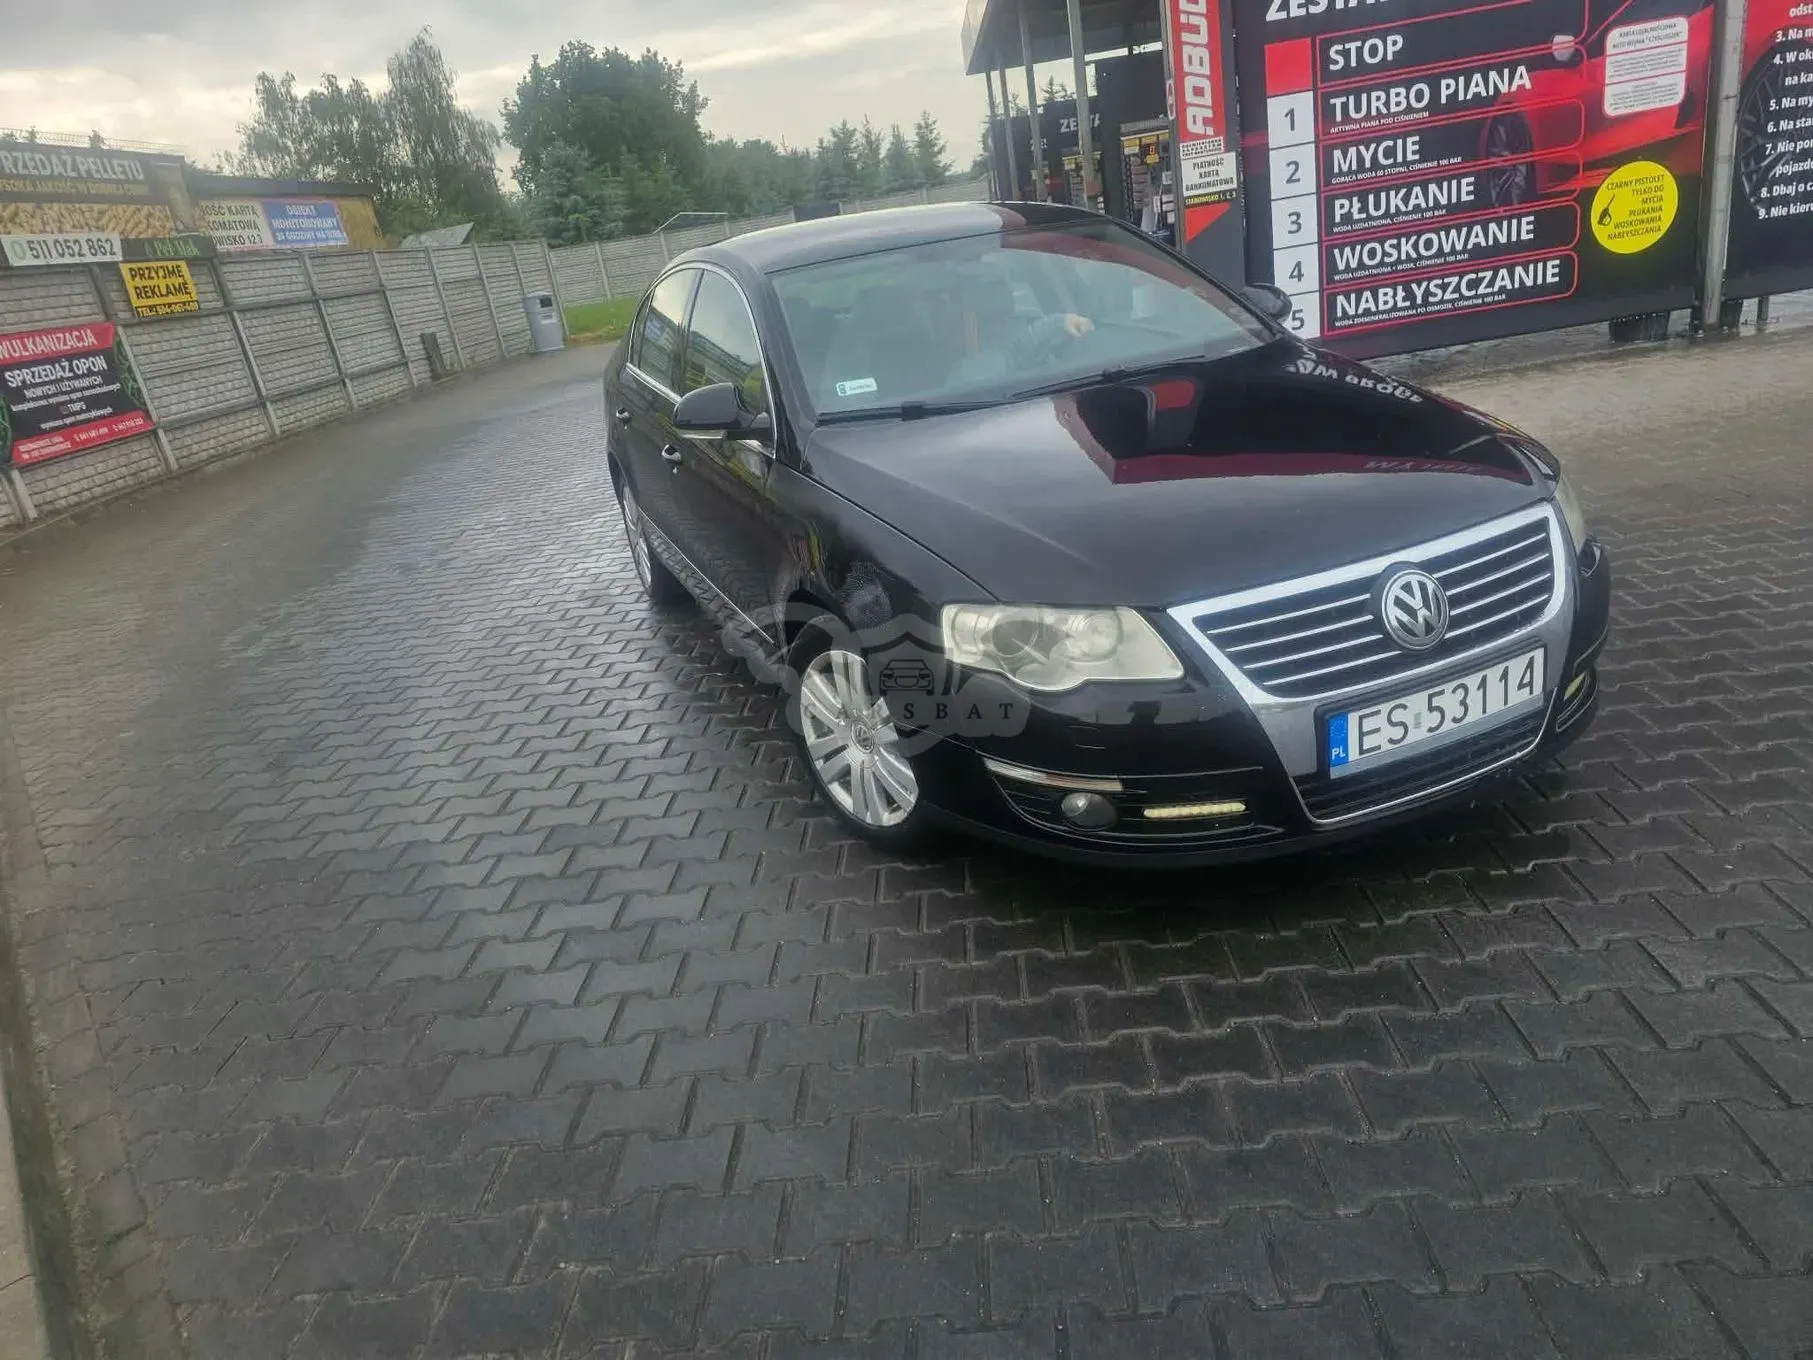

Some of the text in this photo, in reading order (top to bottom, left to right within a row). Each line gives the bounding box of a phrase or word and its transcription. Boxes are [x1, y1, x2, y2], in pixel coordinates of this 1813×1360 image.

[1776, 30, 1786, 42] 3.
[1788, 28, 1803, 40] Na
[1329, 34, 1404, 71] STOP
[1774, 53, 1784, 65] 4.
[1786, 51, 1798, 64] W
[1784, 76, 1798, 86] na
[1330, 65, 1532, 122] TURBO PIANA
[1769, 100, 1779, 111] 5.
[1782, 96, 1797, 109] Na
[1284, 107, 1296, 132] 1
[1330, 110, 1429, 134] AKTYWNA PIANA POD CIŚNIENIEM
[1767, 121, 1777, 133] 6.
[1779, 119, 1794, 131] Na
[1334, 136, 1420, 174] MYCIE
[1766, 143, 1775, 156] 7.
[1777, 140, 1795, 153] Nie
[76, 156, 144, 181] PELLETU
[1286, 160, 1301, 184] 2
[1332, 175, 1356, 184] GORĄCA
[1358, 172, 1376, 180] WODA
[1409, 160, 1438, 171] CIŚNIENIE
[1450, 156, 1462, 165] BAR
[1606, 174, 1664, 191] CZARNY PISTOLET
[1654, 184, 1664, 193] DO
[1760, 186, 1770, 198] 8.
[1772, 180, 1797, 198] Dbaj
[1798, 182, 1805, 192] o
[1334, 177, 1474, 223] PŁUKANIE
[1642, 195, 1664, 204] MYCIA
[1333, 225, 1352, 233] WODA
[1394, 212, 1422, 223] CIŚNIENIE
[1434, 208, 1446, 216] BAR
[1613, 215, 1662, 230] WOSKOWANIA
[1628, 205, 1663, 218] PŁUKANIA
[1758, 207, 1768, 220] 9.
[1770, 204, 1788, 218] Nie
[1288, 211, 1302, 235] 3
[1607, 225, 1662, 240] NABŁYSZCZANIA
[27, 238, 116, 259] 511 052 862
[1334, 216, 1535, 271] WOSKOWANIE
[128, 265, 185, 282] PRZYJMĘ
[1288, 260, 1304, 282] 4
[1334, 272, 1353, 281] WODA
[1354, 266, 1392, 278] UZDATNIONA
[1416, 256, 1444, 268] CIŚNIENIE
[1456, 252, 1469, 260] BAR
[134, 282, 194, 300] REKLAMĘ
[1336, 260, 1560, 317] NABŁYSZCZANIE
[1290, 308, 1305, 331] 5
[1335, 319, 1353, 327] WODA
[1454, 298, 1483, 308] CIŚNIENIE
[1494, 294, 1506, 302] BAR
[0, 328, 98, 360] WULKANIZACJA
[4, 355, 108, 388] SPRZEDAŻ OPON
[1358, 656, 1535, 756] ES 53114
[1332, 746, 1346, 760] PL
